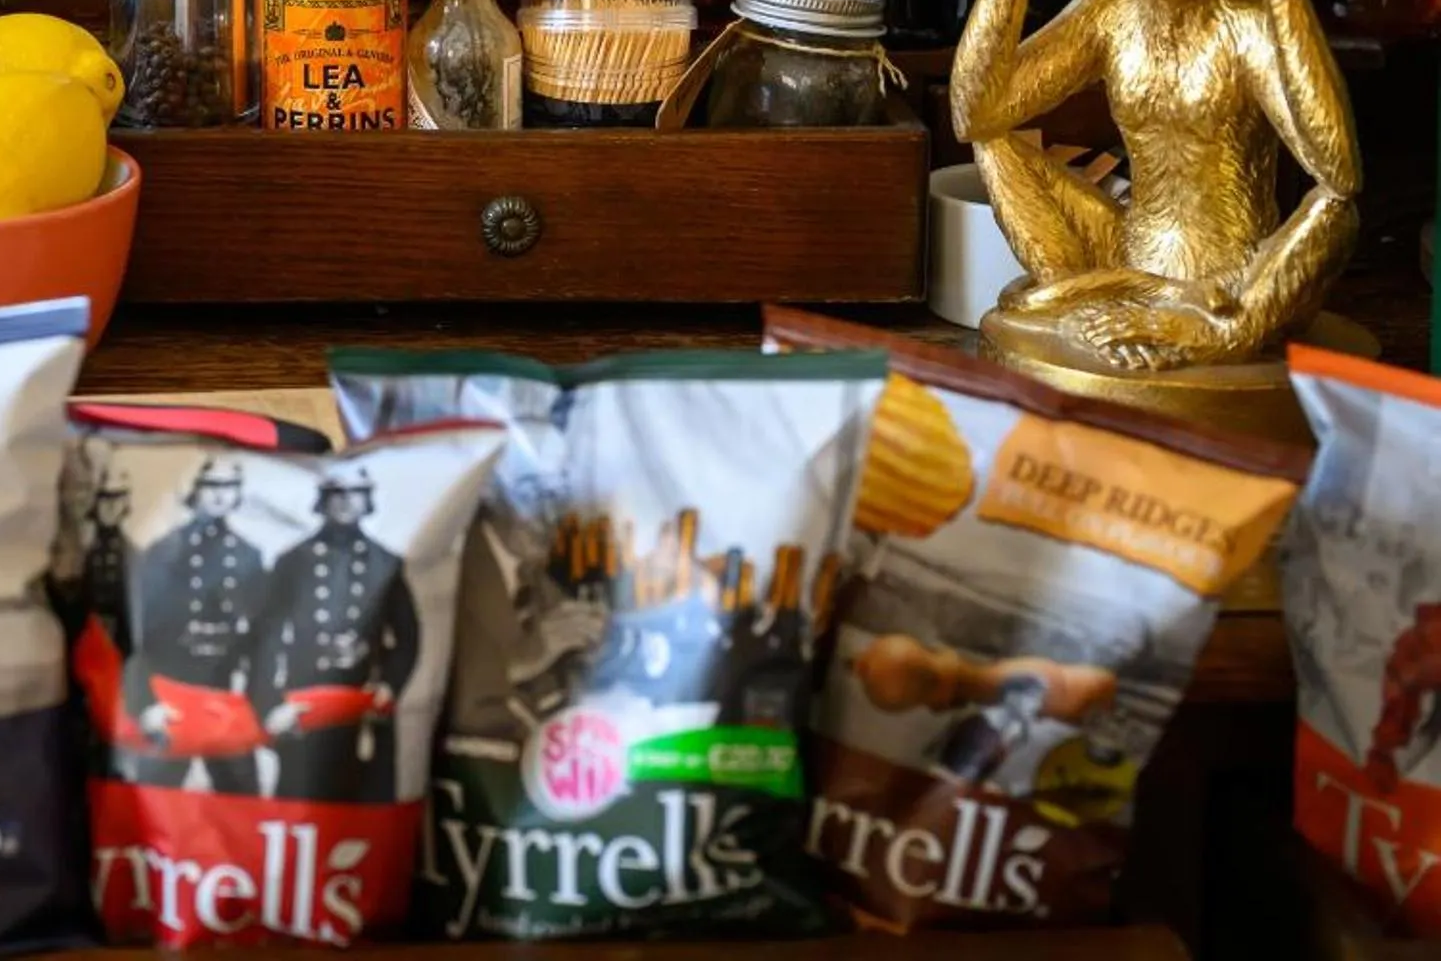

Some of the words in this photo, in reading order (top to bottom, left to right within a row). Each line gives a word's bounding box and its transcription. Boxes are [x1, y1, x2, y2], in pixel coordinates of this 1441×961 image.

[303, 63, 365, 89] LEA
[326, 92, 341, 111] &
[274, 106, 396, 131] PERRINS
[1008, 452, 1102, 504] DEEP
